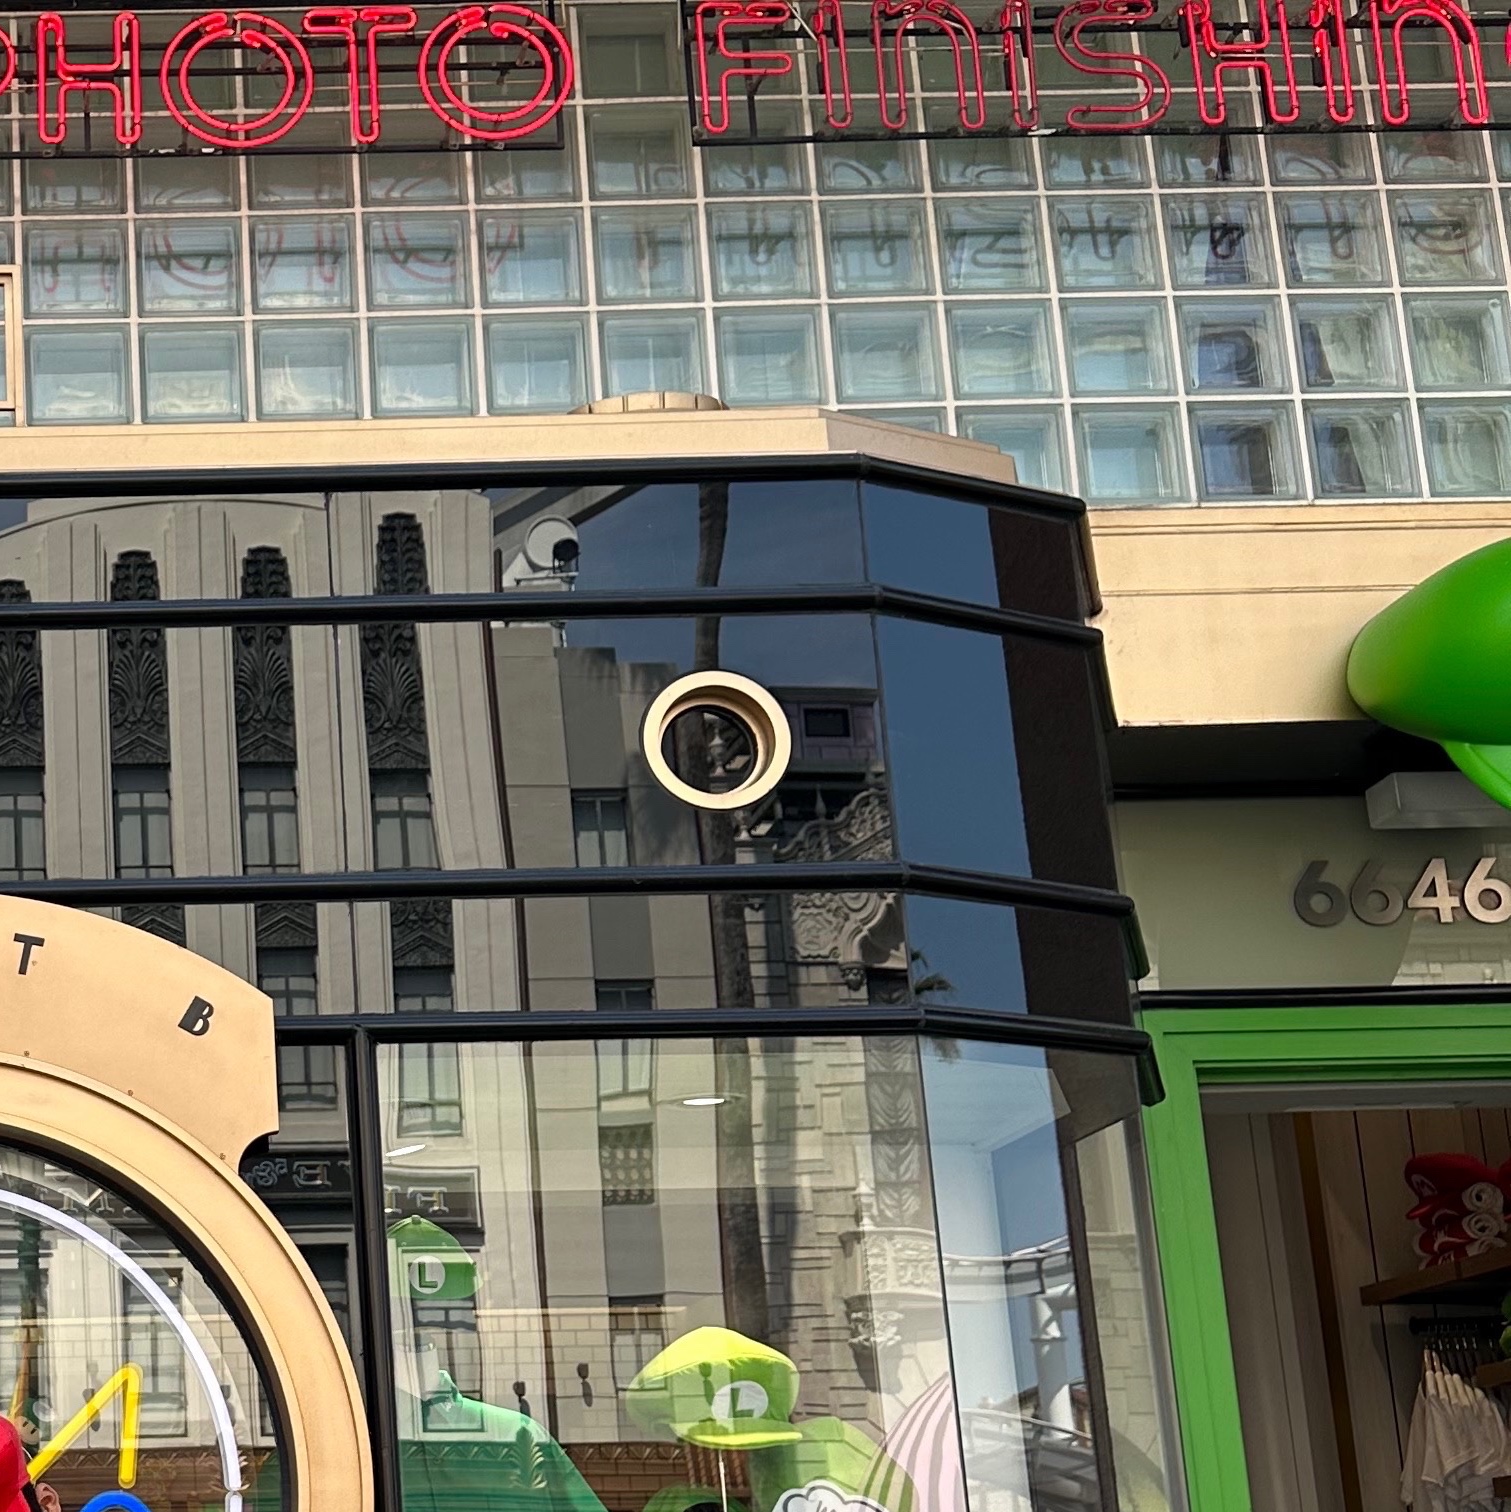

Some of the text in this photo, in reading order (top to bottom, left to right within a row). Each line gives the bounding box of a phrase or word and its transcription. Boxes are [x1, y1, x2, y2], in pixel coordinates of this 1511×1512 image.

[694, 0, 1511, 133] FINISHIN
[1293, 857, 1511, 928] 6646
[13, 932, 45, 976] T
[177, 996, 216, 1036] B
[418, 1262, 438, 1289] L
[729, 1387, 755, 1419] L
